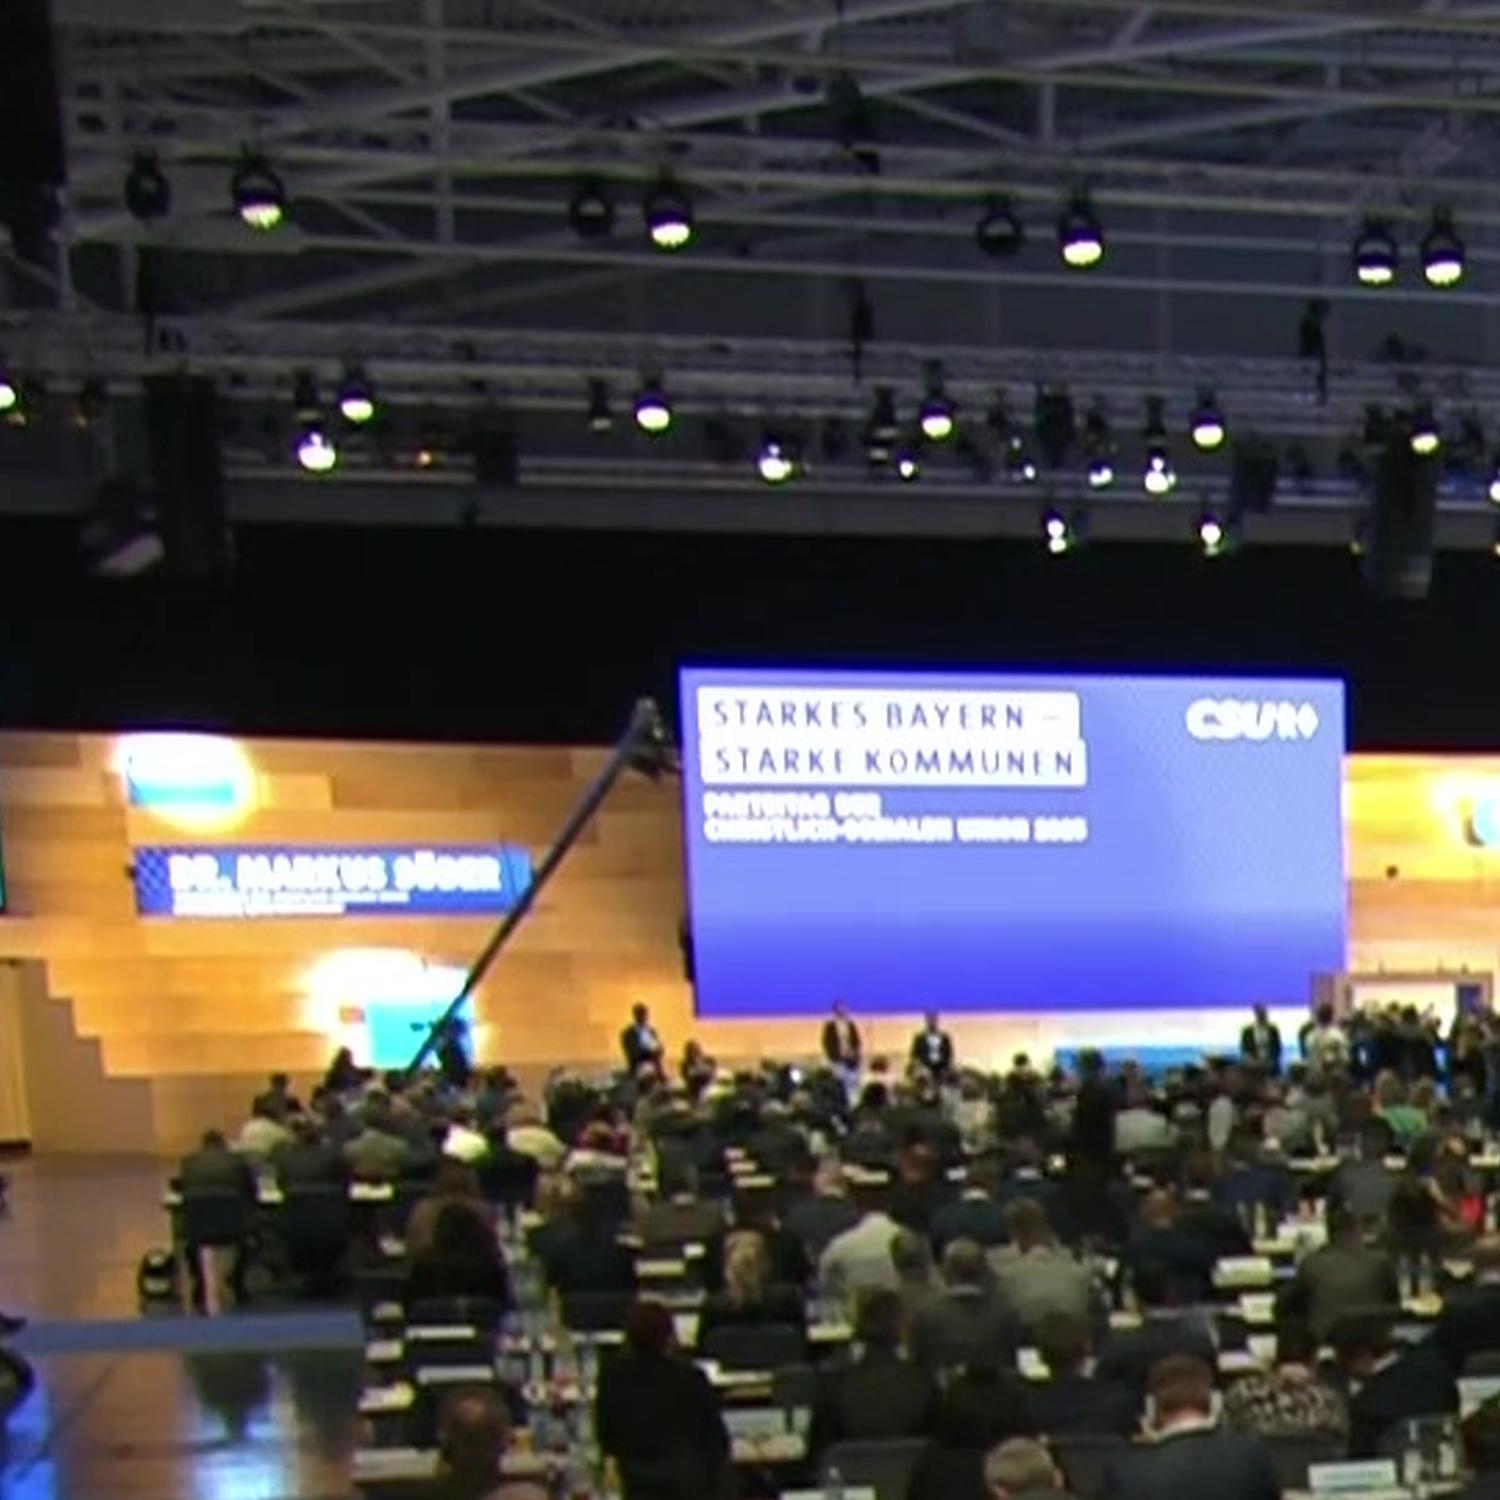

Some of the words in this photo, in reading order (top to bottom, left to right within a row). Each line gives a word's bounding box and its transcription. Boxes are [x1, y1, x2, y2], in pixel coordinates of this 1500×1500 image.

[713, 700, 868, 728] STARKES
[886, 702, 1024, 729] BAYERN
[716, 747, 842, 774] STARKE
[864, 748, 1073, 776] KOMMUNEN
